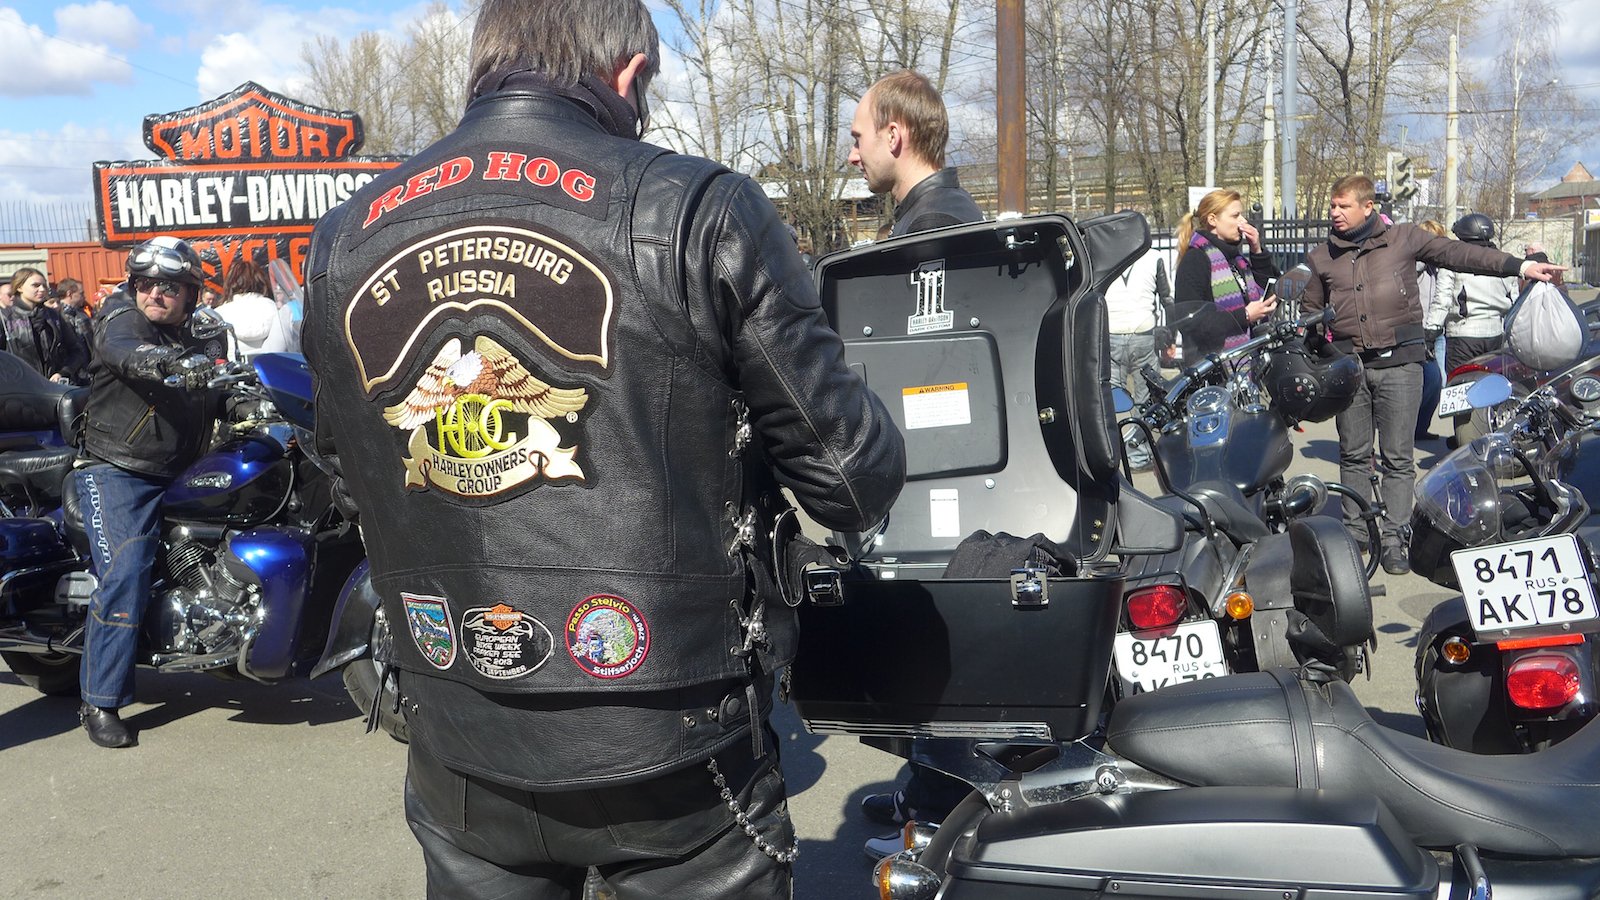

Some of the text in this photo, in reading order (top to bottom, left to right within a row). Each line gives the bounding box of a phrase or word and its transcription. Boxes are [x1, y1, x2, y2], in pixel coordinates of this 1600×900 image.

[181, 106, 329, 159] MOTOR
[117, 173, 380, 227] HARLEY-DAVIDS
[362, 151, 597, 229] RED HOG
[370, 237, 574, 307] ST PETERSBURG
[427, 270, 517, 303] RUSSIA
[924, 385, 955, 393] WARNING
[1441, 402, 1456, 413] BA
[432, 448, 528, 478] HARLEY OWNERS
[456, 476, 502, 494] GROUP
[1473, 547, 1562, 584] 8471
[1525, 577, 1557, 591] RUS
[568, 598, 631, 633] Passo Stelvio
[1479, 588, 1585, 626] AK 78
[493, 658, 513, 666] 2013
[502, 650, 523, 658] SEE
[592, 646, 645, 676] Stilfserjoch
[1131, 633, 1203, 666] 8470
[1173, 662, 1199, 674] RUS
